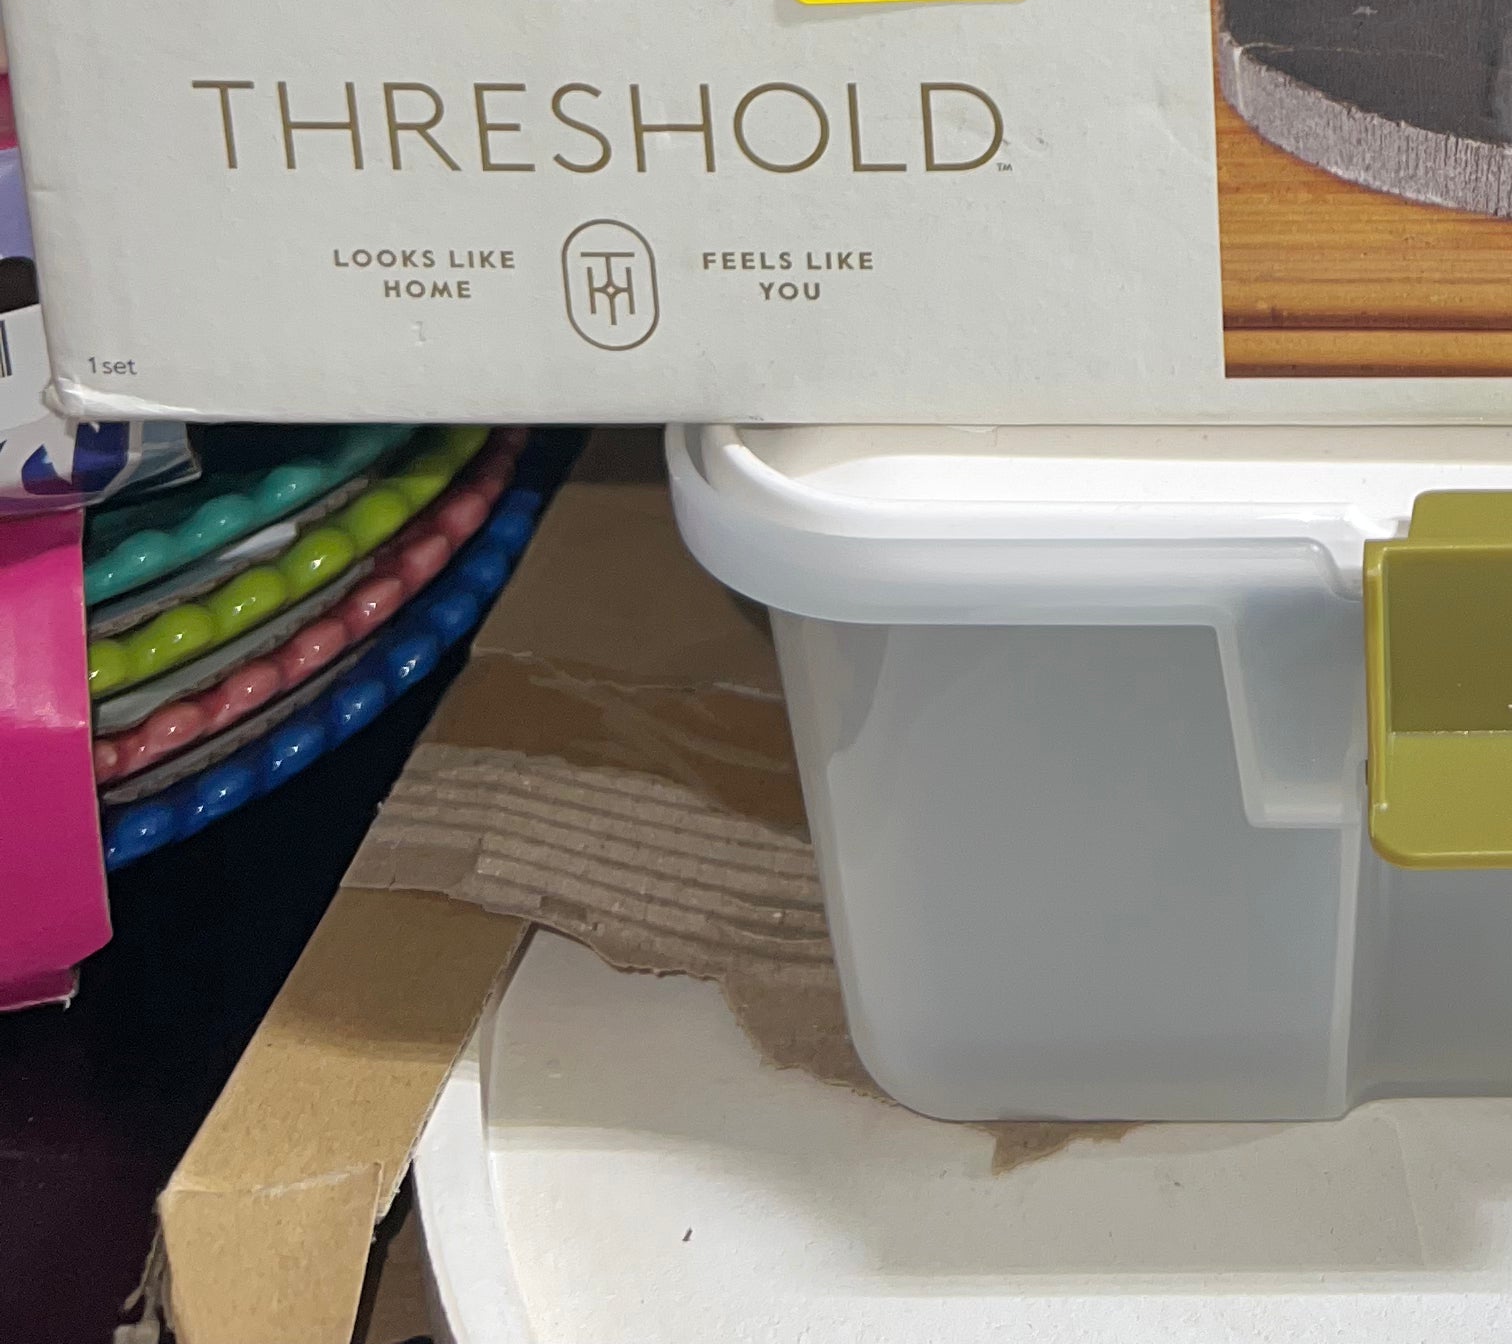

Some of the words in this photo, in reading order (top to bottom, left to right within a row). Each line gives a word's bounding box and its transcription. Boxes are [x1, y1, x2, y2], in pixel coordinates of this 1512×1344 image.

[191, 80, 1004, 174] THRESHOLD
[333, 248, 437, 269] LOOKS
[449, 249, 516, 269] LIKE
[702, 250, 793, 270] FEELS
[806, 250, 875, 271] LIKE
[383, 279, 472, 299] HOME
[758, 281, 822, 301] YOU
[88, 356, 97, 374] 1
[102, 357, 138, 375] set
